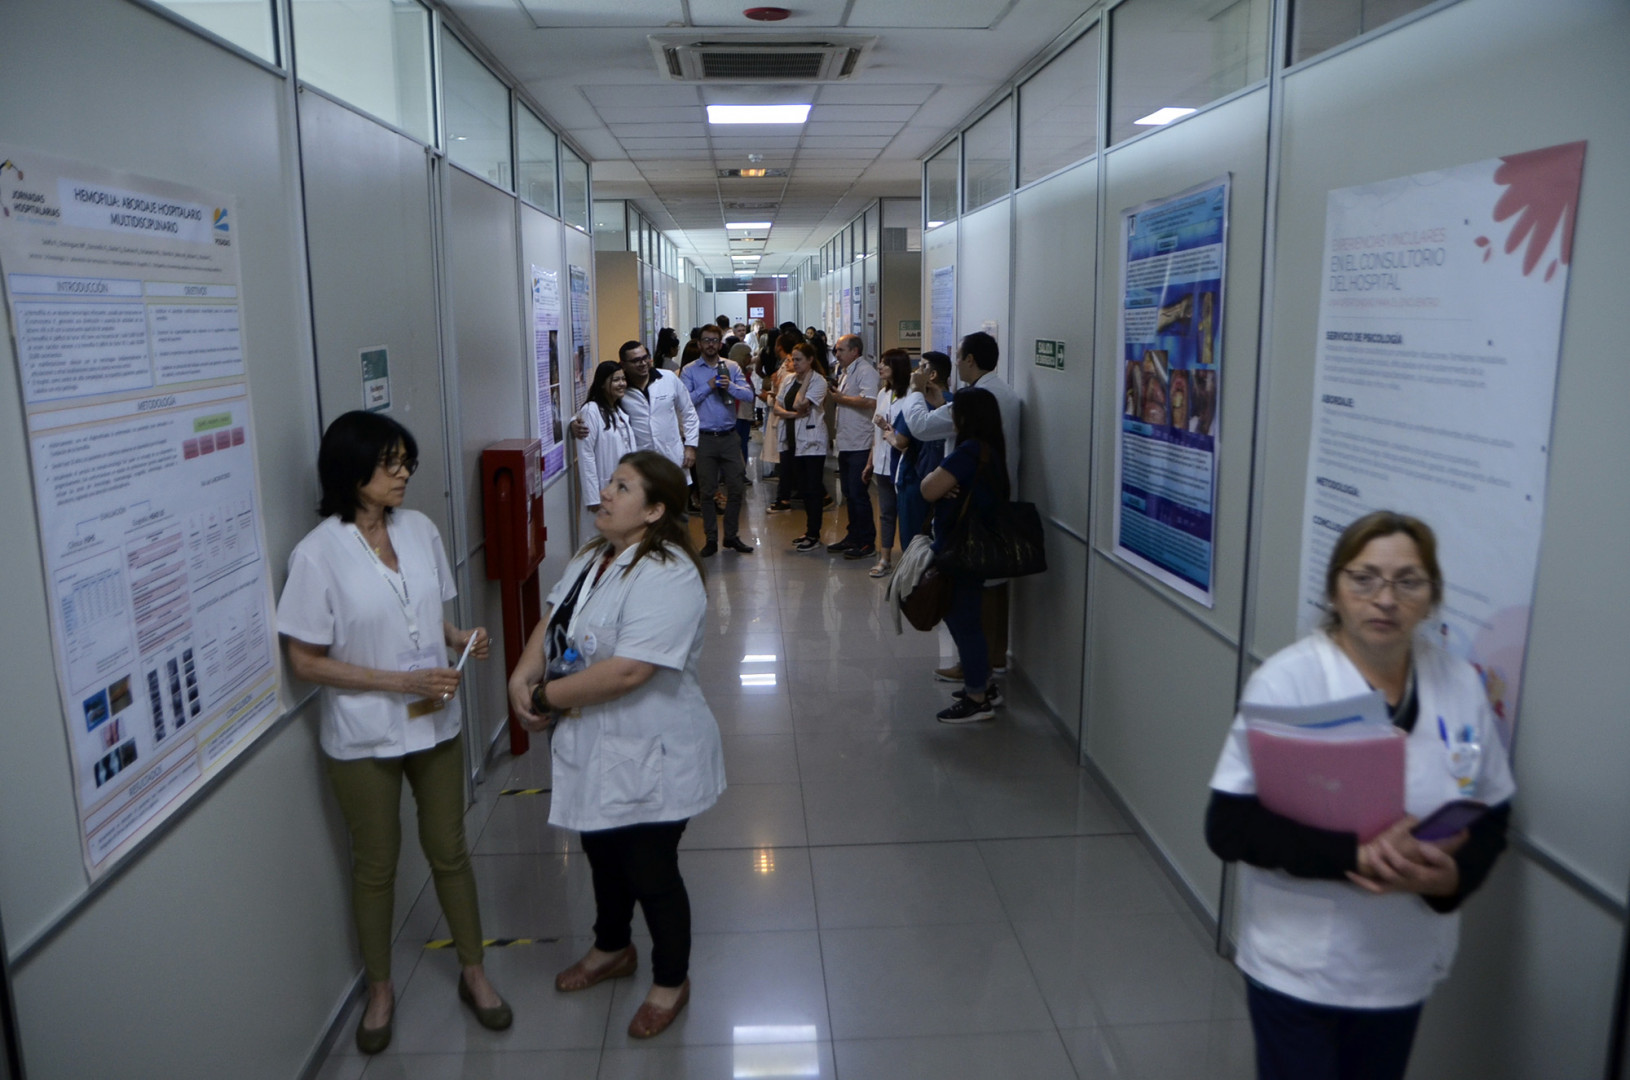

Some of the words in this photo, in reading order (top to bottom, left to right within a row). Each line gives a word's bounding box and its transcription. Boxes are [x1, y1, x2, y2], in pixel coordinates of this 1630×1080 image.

[12, 190, 45, 203] JORNADAS
[74, 188, 119, 207] HEMOFILIA:
[122, 197, 157, 214] ABORDAJE
[158, 203, 202, 221] HOSPITALARIO
[14, 203, 61, 217] HOSPITALARIAS
[111, 213, 179, 234] MULTIDISCIPLINARIO
[1361, 247, 1446, 270] CONSULTORIO
[1329, 275, 1348, 292] DEL
[1350, 272, 1402, 291] HOSPITAL
